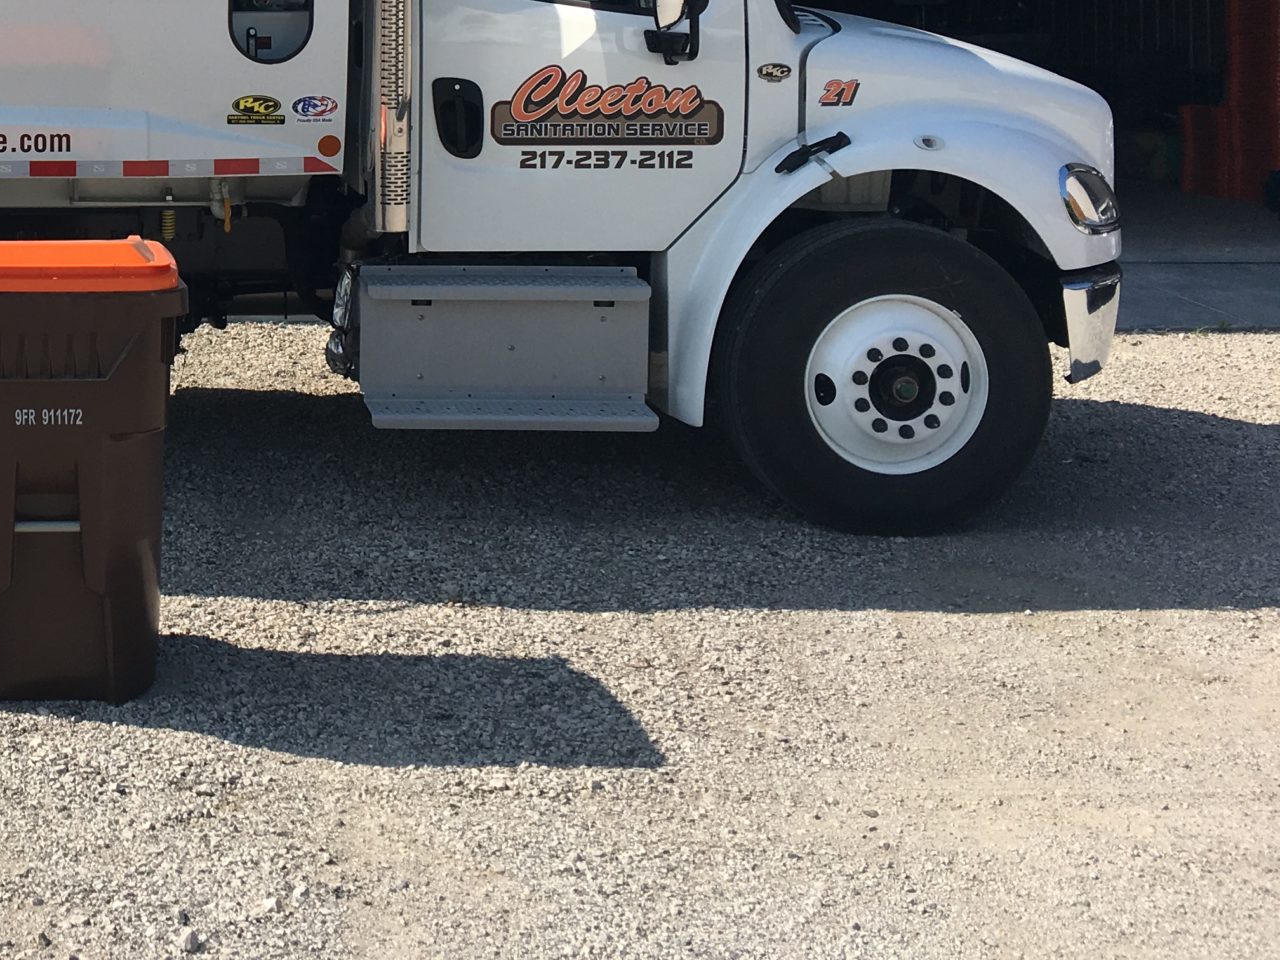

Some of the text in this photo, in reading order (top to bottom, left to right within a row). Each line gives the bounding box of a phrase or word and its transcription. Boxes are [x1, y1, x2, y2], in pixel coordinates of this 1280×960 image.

[510, 64, 704, 123] Cleeton
[818, 79, 861, 106] 21
[239, 95, 275, 113] RTC
[502, 122, 709, 137] SANITATION SERVICE
[519, 150, 694, 169] 217-237-2112
[15, 409, 83, 425] 9FR 911172
